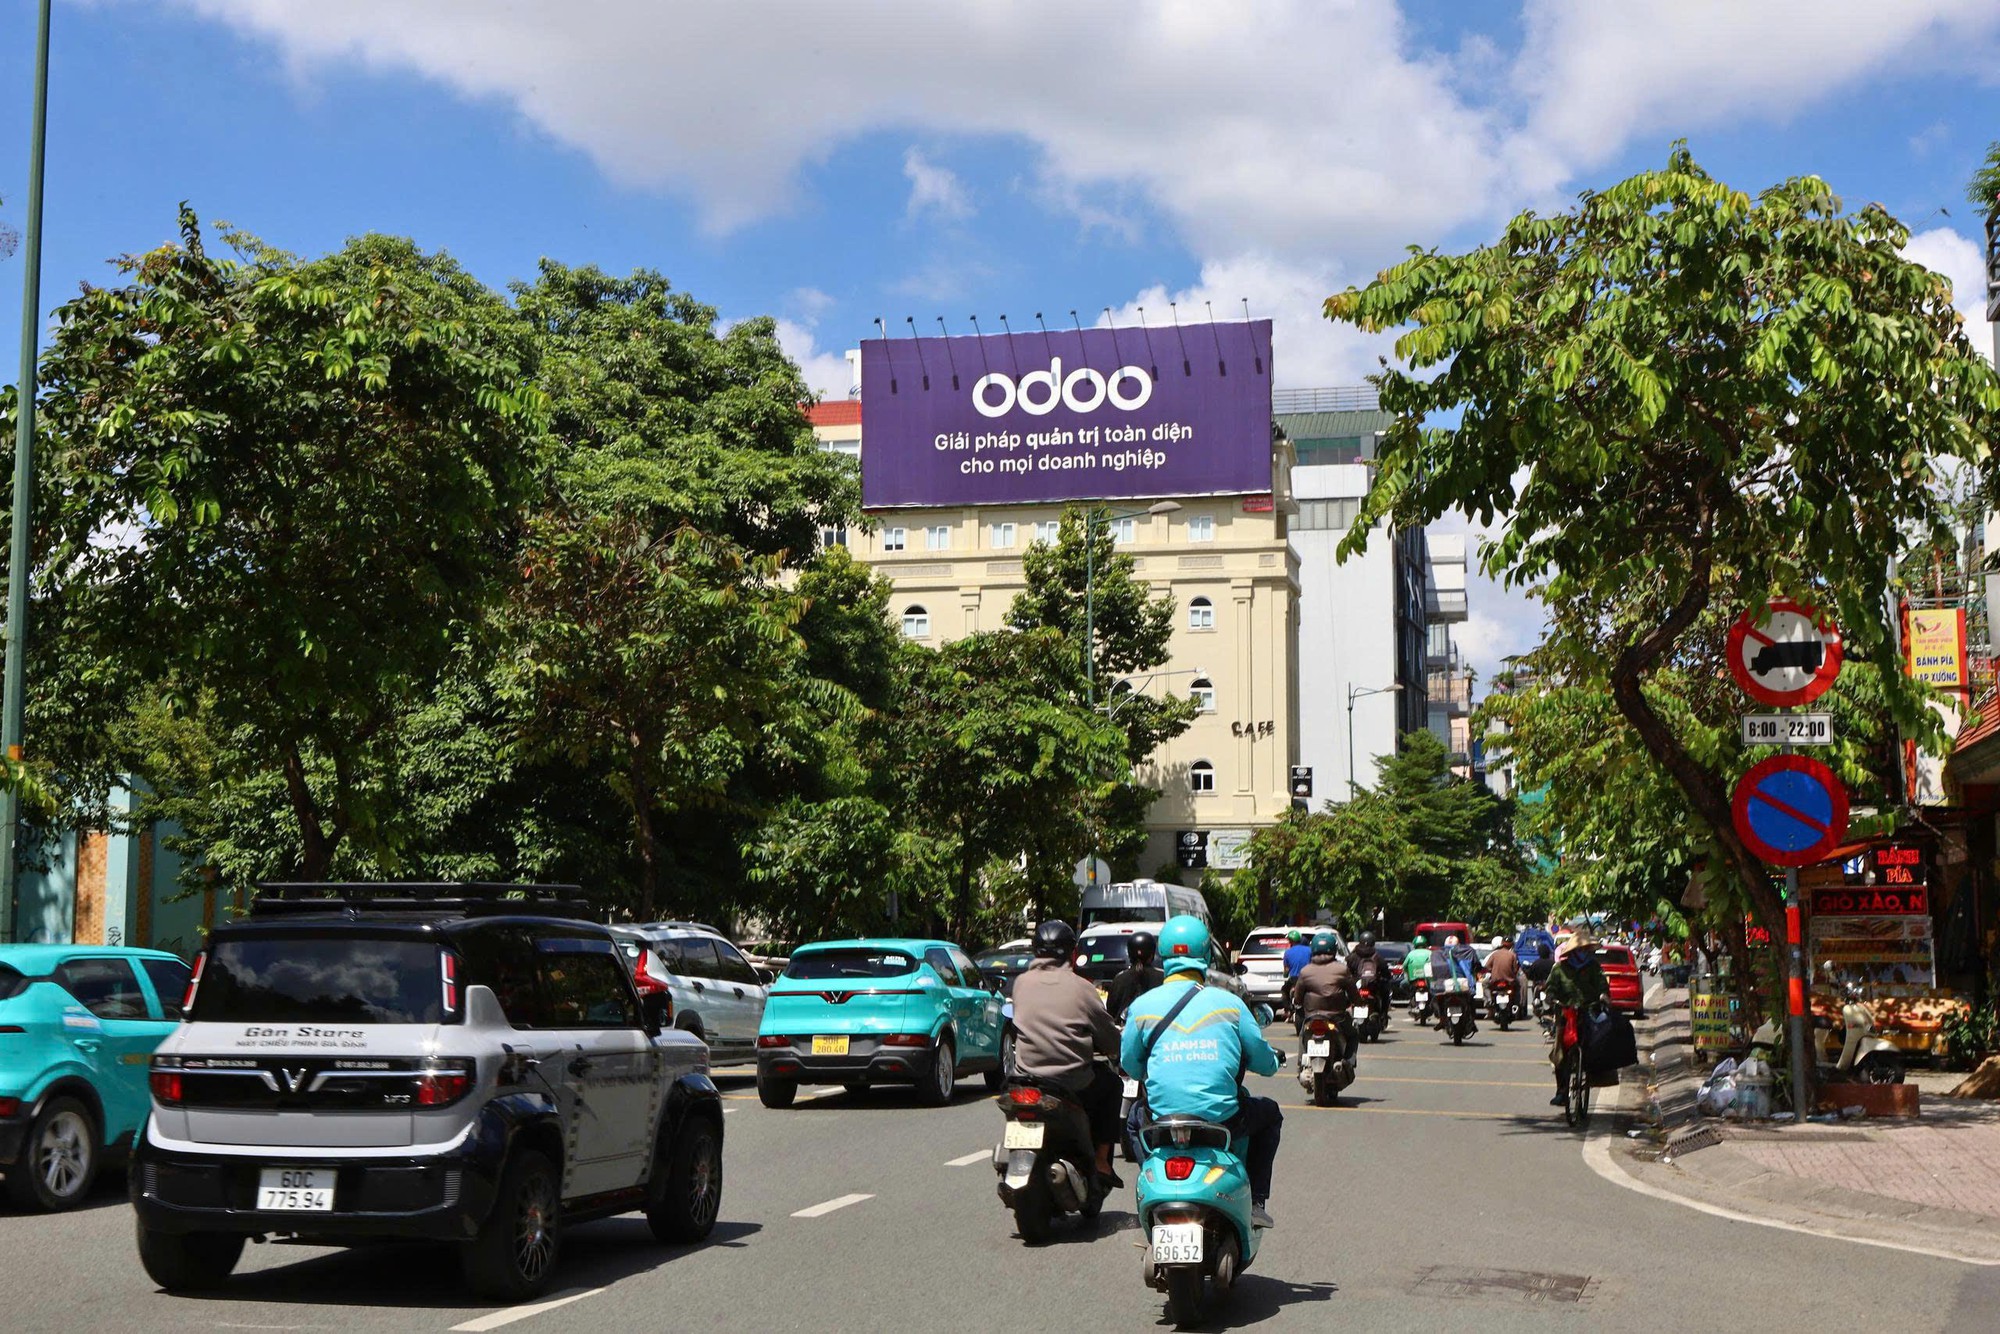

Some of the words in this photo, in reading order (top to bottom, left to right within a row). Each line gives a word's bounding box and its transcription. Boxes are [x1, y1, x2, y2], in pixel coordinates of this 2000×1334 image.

[972, 356, 1152, 418] odoo
[934, 431, 970, 451] Giải
[975, 430, 1021, 453] pháp
[1026, 427, 1074, 450] quản
[1078, 426, 1100, 447] trị
[1104, 424, 1147, 443] toàn
[1152, 422, 1193, 443] diện
[960, 455, 995, 474] cho
[1000, 454, 1033, 475] mọi
[1038, 452, 1096, 471] doanh
[1102, 449, 1166, 471] nghiệp
[1231, 720, 1274, 736] CAFE
[1749, 721, 1776, 737] 6:00
[1789, 721, 1824, 737] 22:00
[282, 1171, 314, 1188] 60C
[267, 1191, 324, 1208] 775.94
[1155, 1245, 1199, 1261] 696.52
